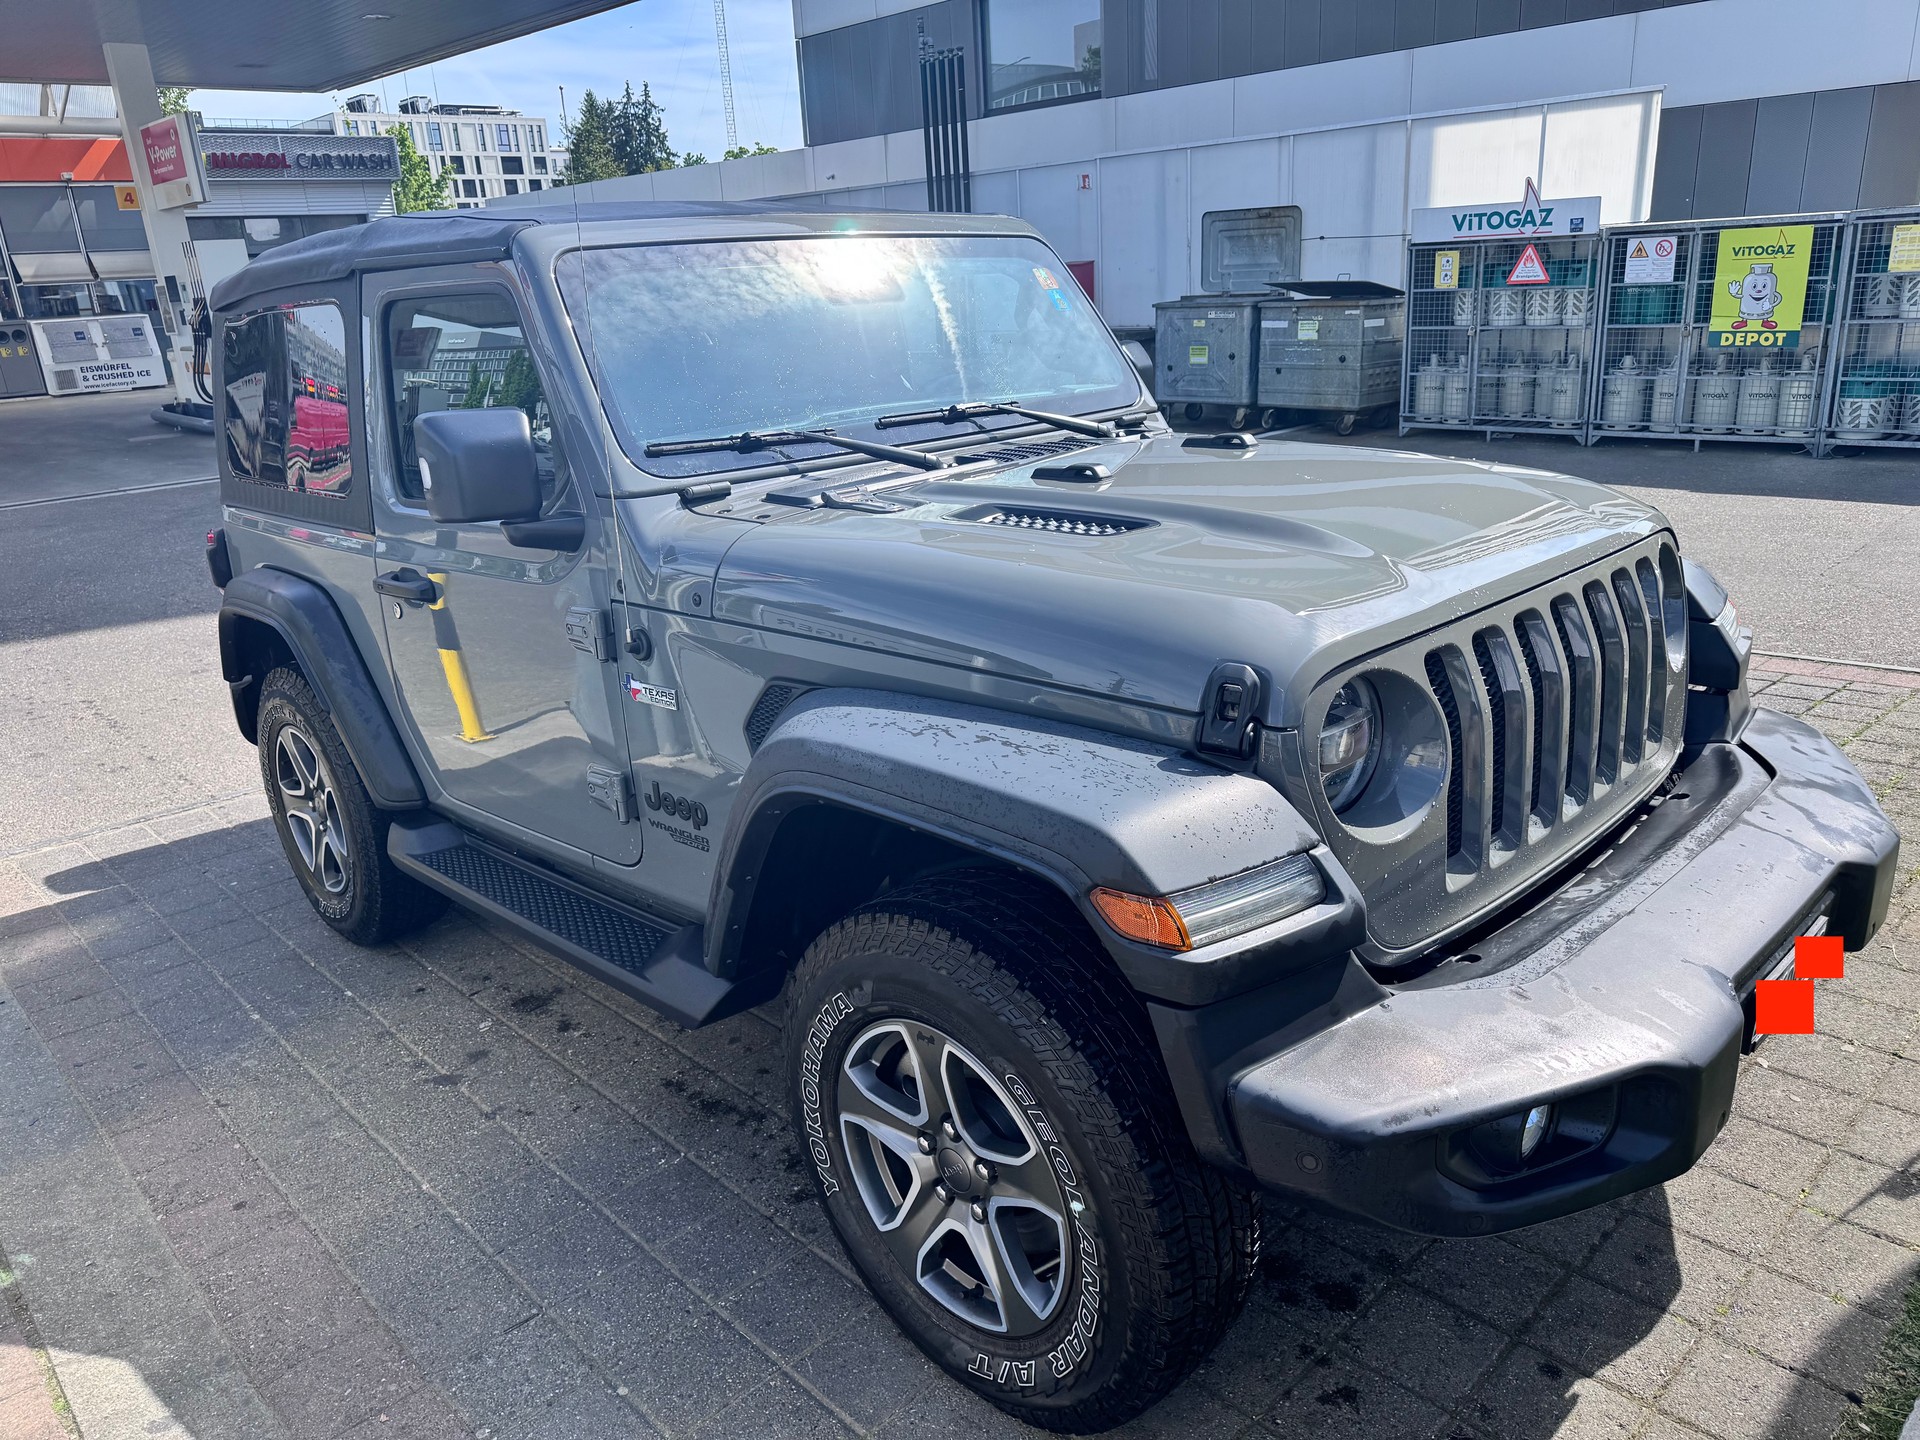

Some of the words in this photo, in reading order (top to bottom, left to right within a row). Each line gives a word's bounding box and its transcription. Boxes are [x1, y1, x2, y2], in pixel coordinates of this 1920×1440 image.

[149, 145, 177, 164] V-Power
[211, 152, 291, 169] MIGROL
[296, 153, 334, 169] CAR
[339, 153, 392, 169] WASH
[124, 192, 134, 205] 4
[1720, 332, 1787, 346] DEPOT
[80, 362, 132, 374] EISWÜRFEL
[92, 371, 135, 381] CRUSHED
[136, 369, 152, 377] ICE
[84, 380, 137, 390] www.icefactory.ch
[642, 686, 675, 701] TEXAS
[650, 697, 676, 708] EDITION
[644, 780, 708, 831] Jeep
[648, 817, 710, 846] WRANGLER
[801, 992, 854, 1197] YOKOHAMA
[1005, 1073, 1100, 1379] GEOLANDAR
[968, 1353, 1036, 1386] A/T
